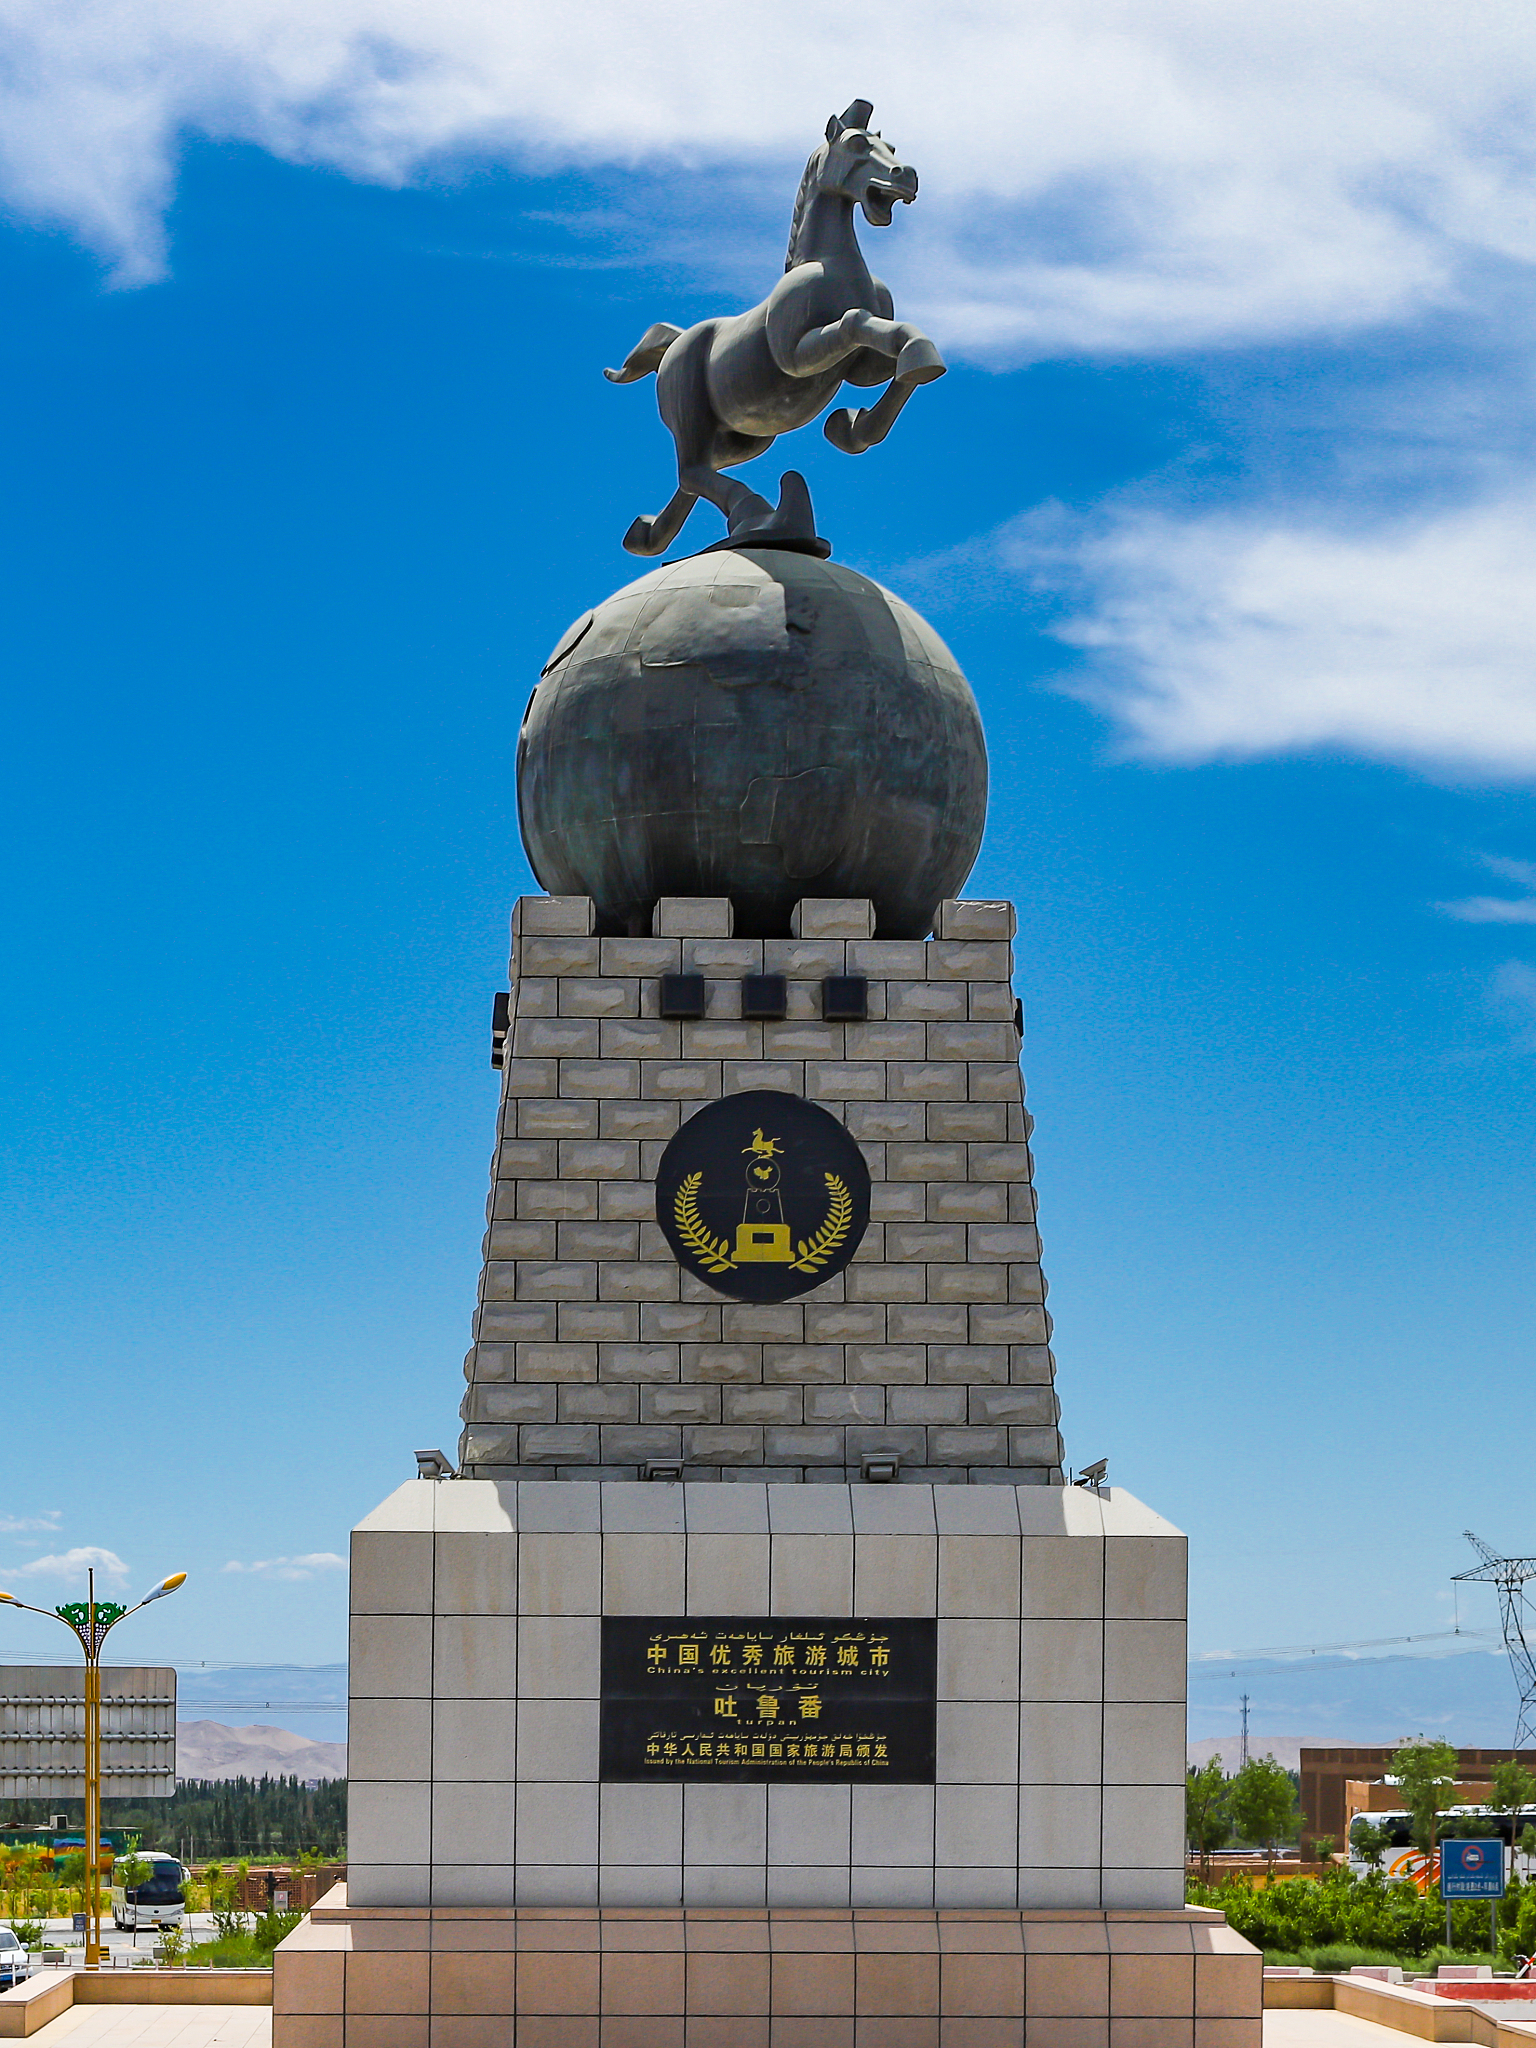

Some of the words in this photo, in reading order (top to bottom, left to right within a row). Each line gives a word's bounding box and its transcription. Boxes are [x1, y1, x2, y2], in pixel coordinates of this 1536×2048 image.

[646, 1643, 891, 1667] 中国优秀旅游城市
[646, 1666, 705, 1674] China's
[712, 1667, 784, 1675] excellent
[860, 1668, 890, 1677] city
[714, 1694, 823, 1719] 吐鲁番
[737, 1719, 797, 1727] turpan
[646, 1742, 889, 1758] 中华人民共和国国家旅游局颁发
[644, 1757, 664, 1765] Issued
[665, 1758, 674, 1766] by
[835, 1759, 863, 1767] Republic
